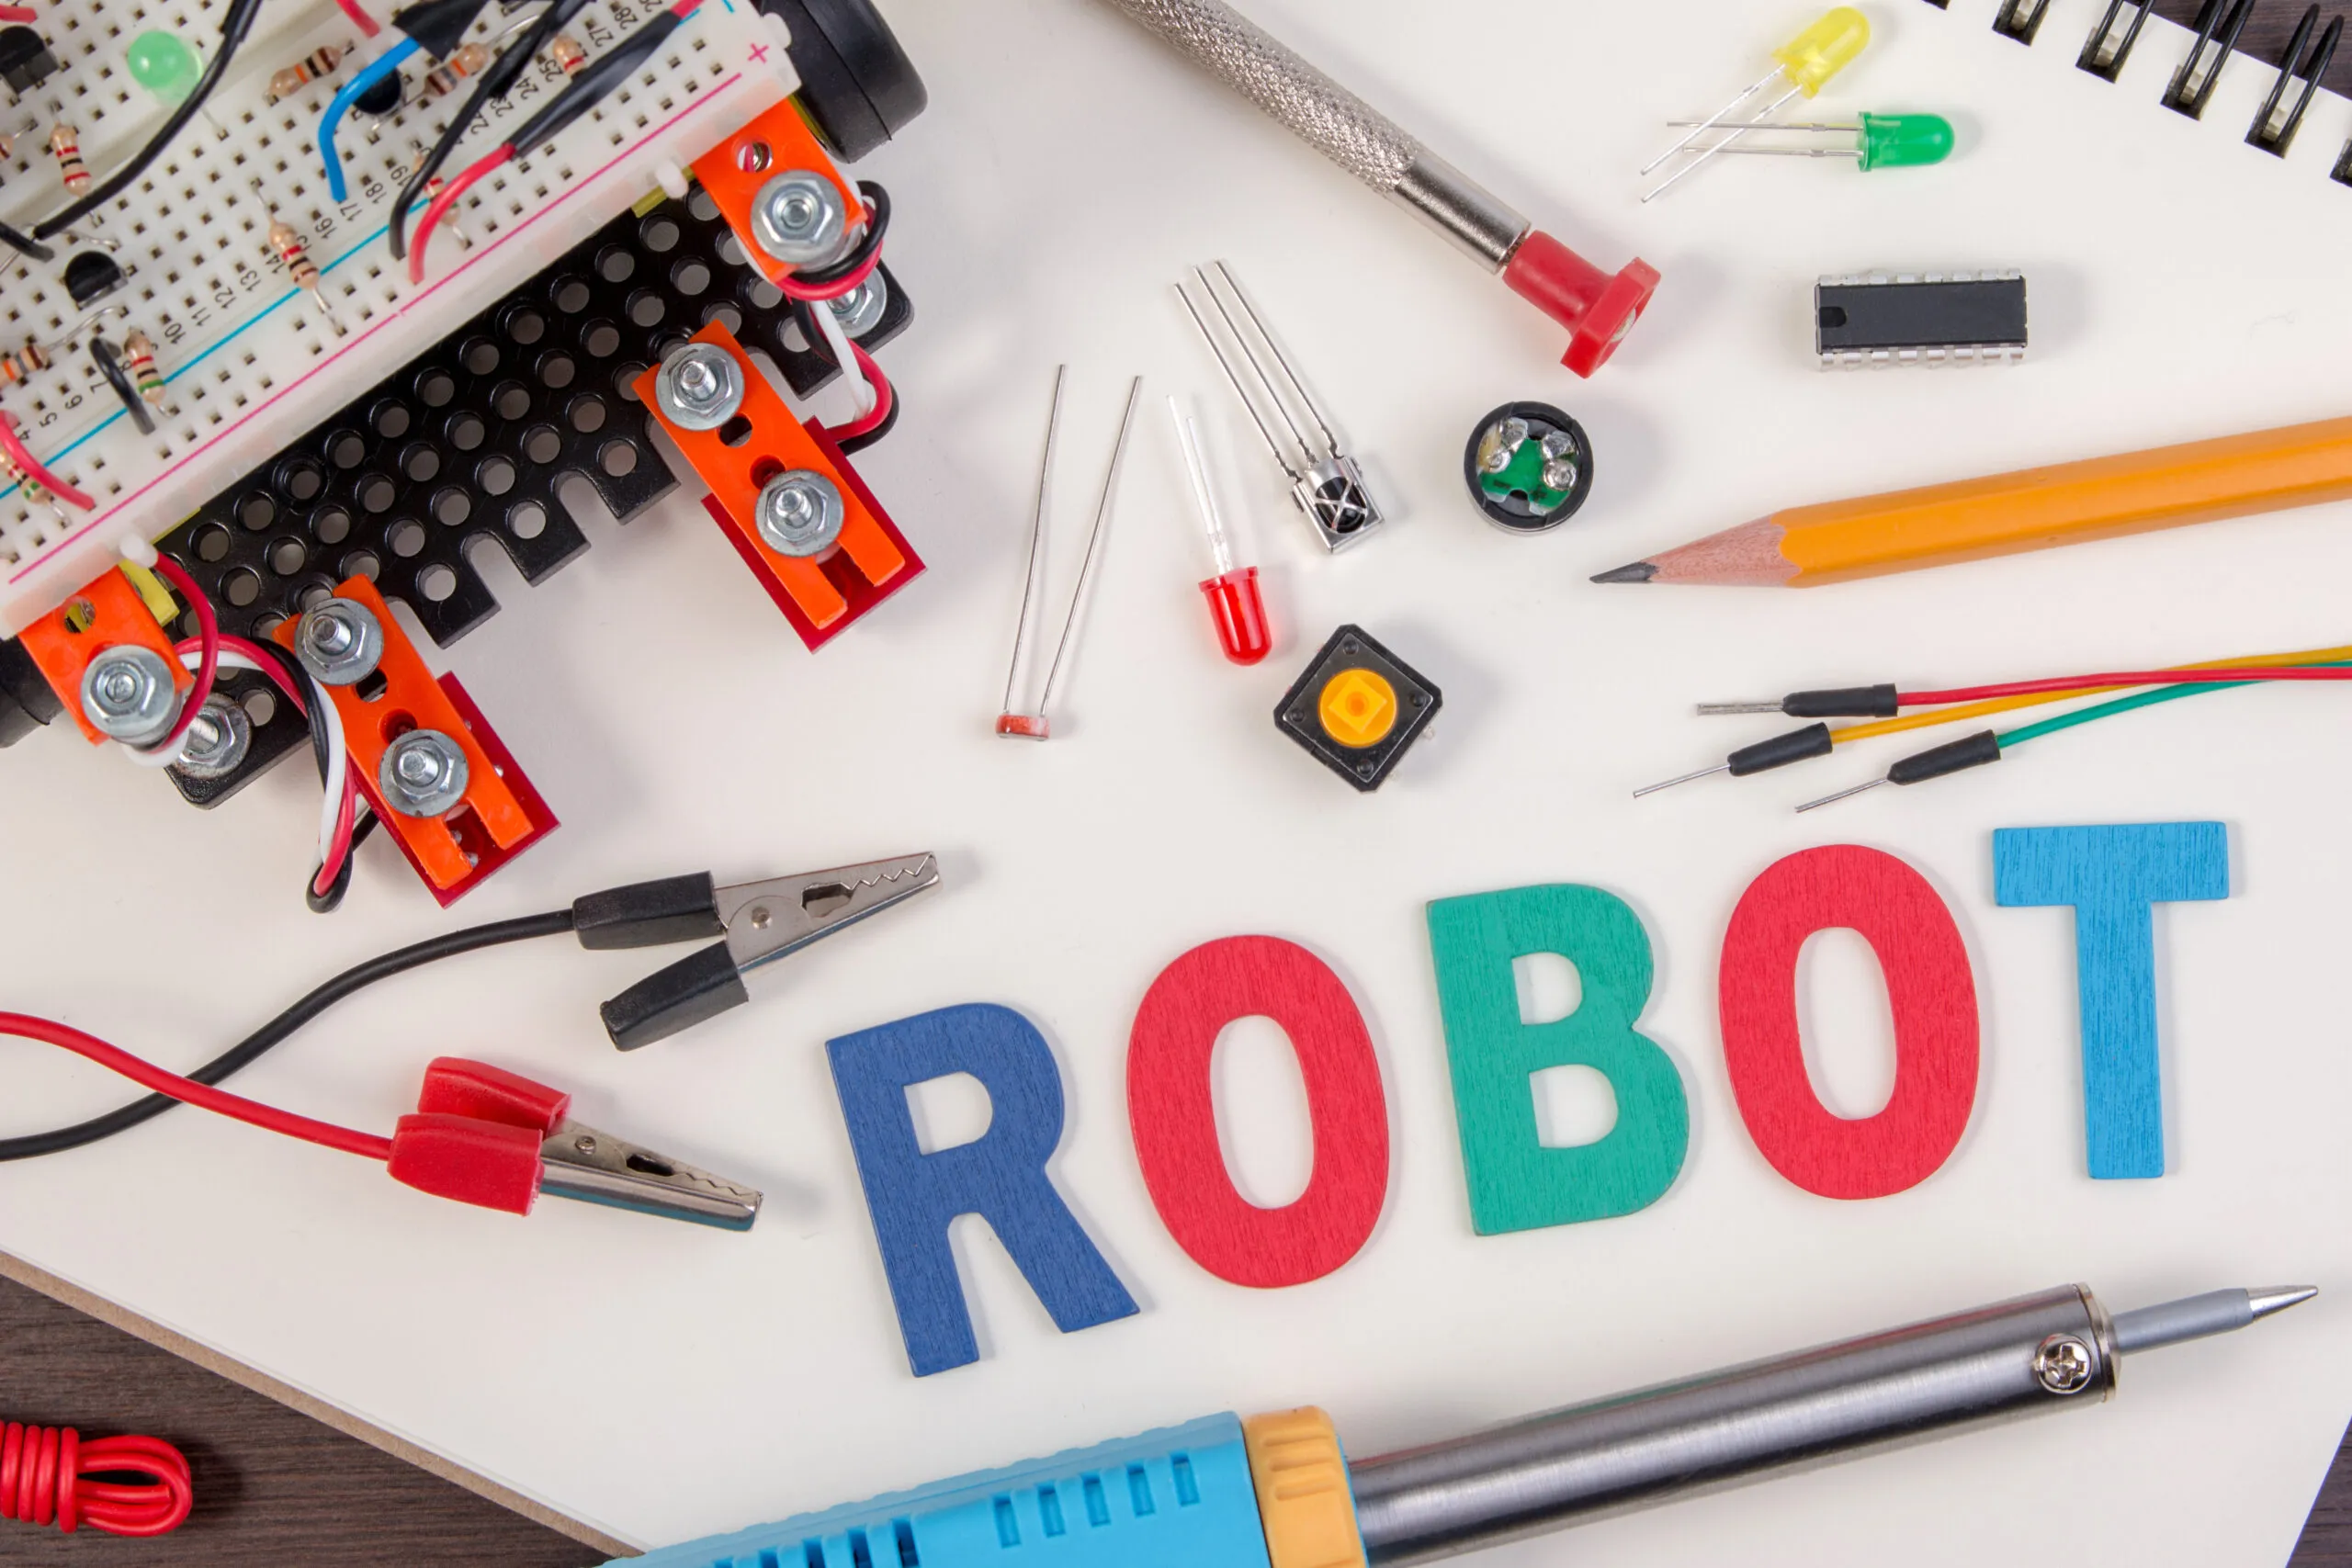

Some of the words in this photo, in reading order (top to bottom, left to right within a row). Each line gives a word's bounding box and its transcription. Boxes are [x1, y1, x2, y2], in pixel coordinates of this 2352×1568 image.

[614, 6, 639, 30] 28
[589, 26, 614, 47] 27
[538, 59, 564, 83] 25
[515, 76, 539, 100] 24
[390, 164, 413, 186] 19
[365, 182, 388, 205] 18
[339, 202, 363, 221] 17
[314, 218, 337, 240] 16
[266, 254, 286, 274] 14
[240, 270, 262, 292] 13
[214, 287, 237, 310] 12
[191, 307, 212, 326] 11
[164, 322, 187, 344] 10
[39, 412, 58, 428] 5
[826, 820, 2230, 1379] ROBOT
